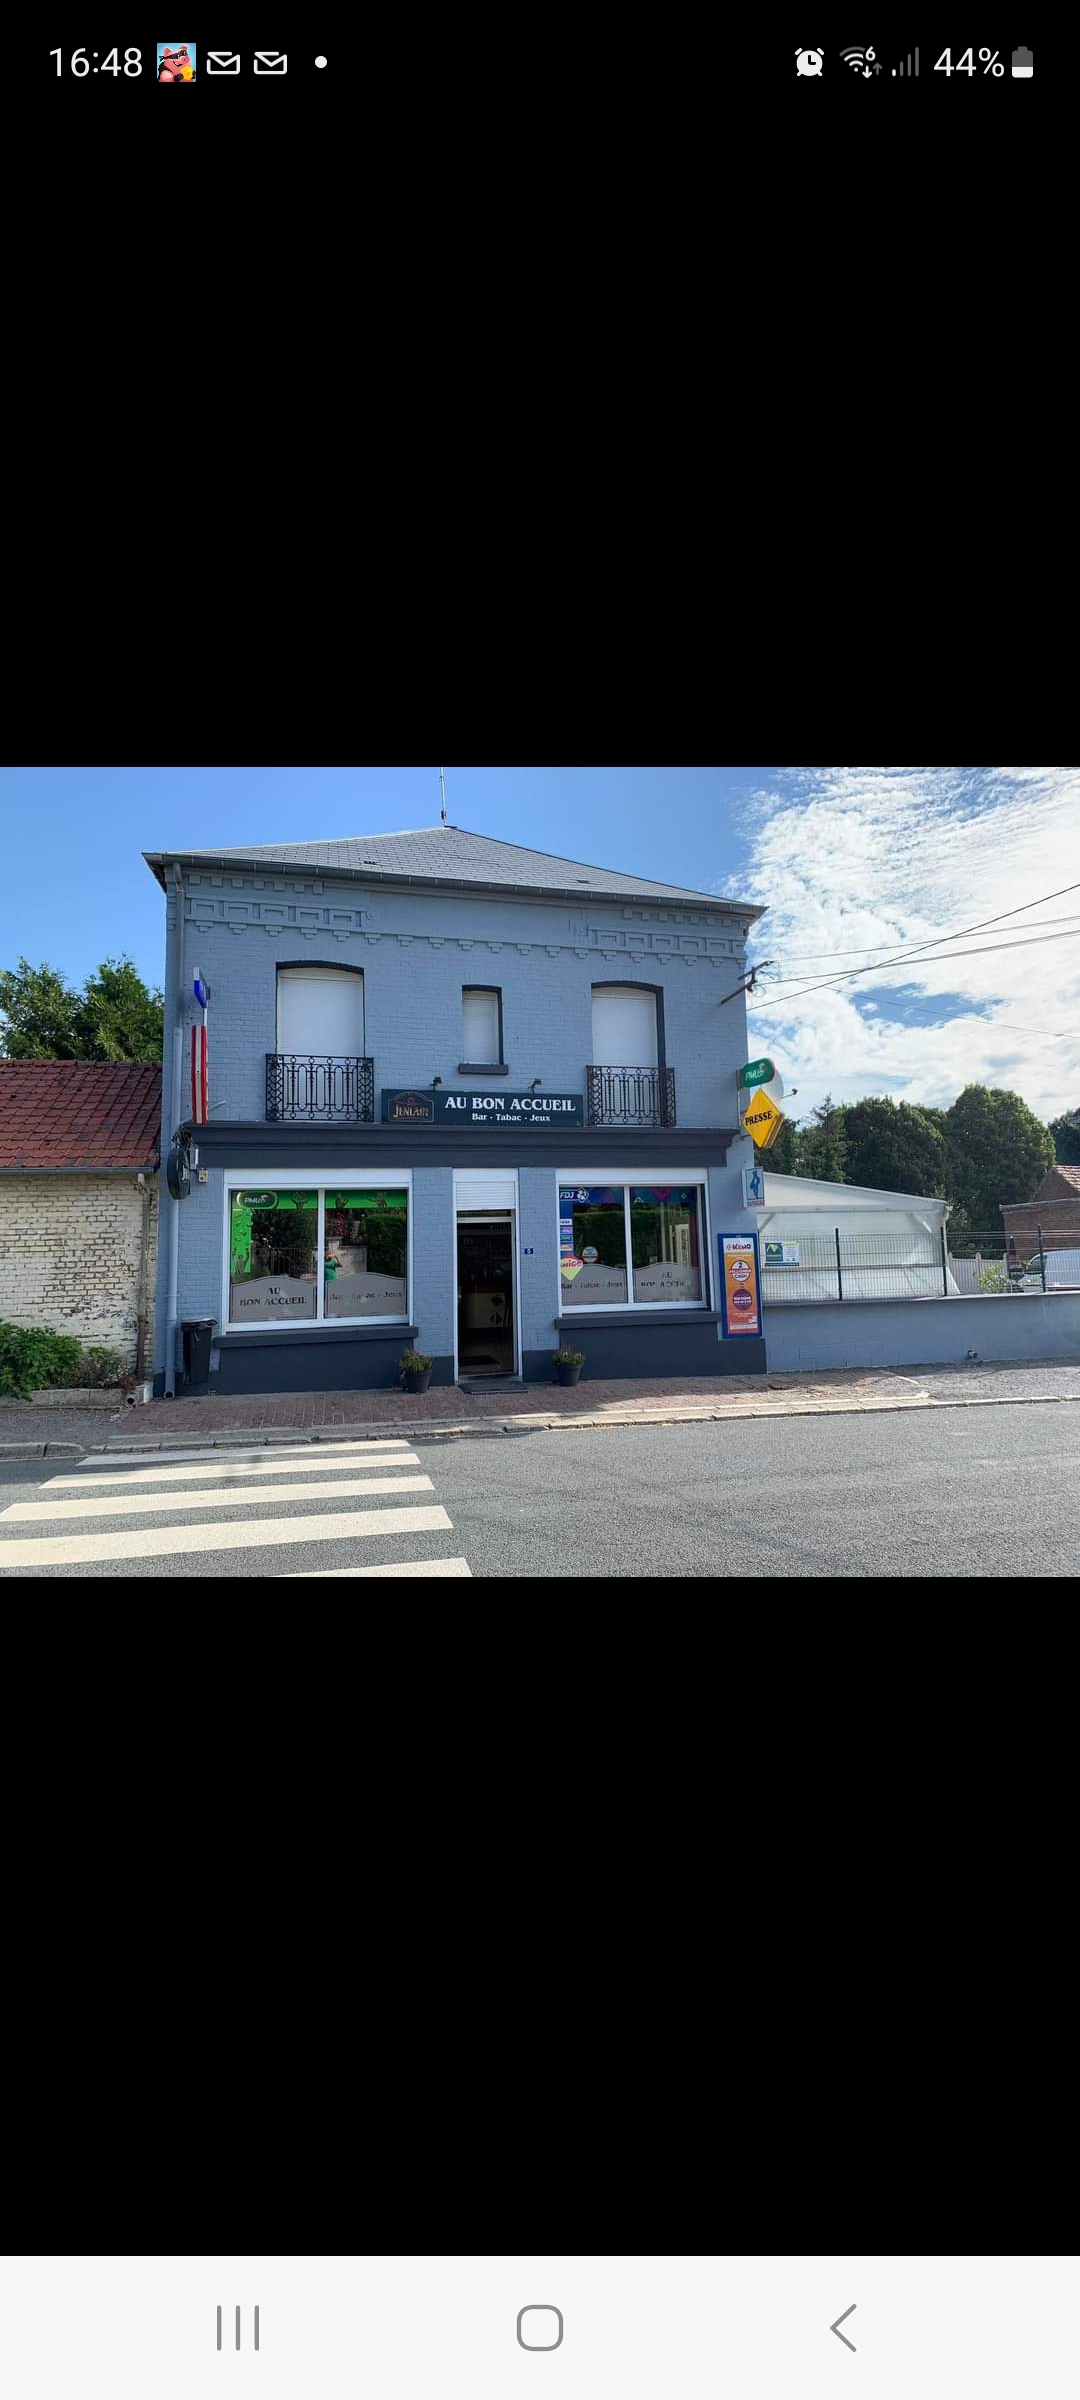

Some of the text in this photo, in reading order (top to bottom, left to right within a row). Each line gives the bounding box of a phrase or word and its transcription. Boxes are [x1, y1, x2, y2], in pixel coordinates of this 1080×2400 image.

[445, 1096, 576, 1112] AU BON ACCUEIL
[472, 1113, 487, 1121] Bar
[496, 1113, 522, 1121] Tabac
[530, 1114, 551, 1122] Jeux
[745, 1110, 773, 1126] PRESSE
[267, 1287, 281, 1295] AU
[264, 1296, 308, 1306] ACCUEIL
